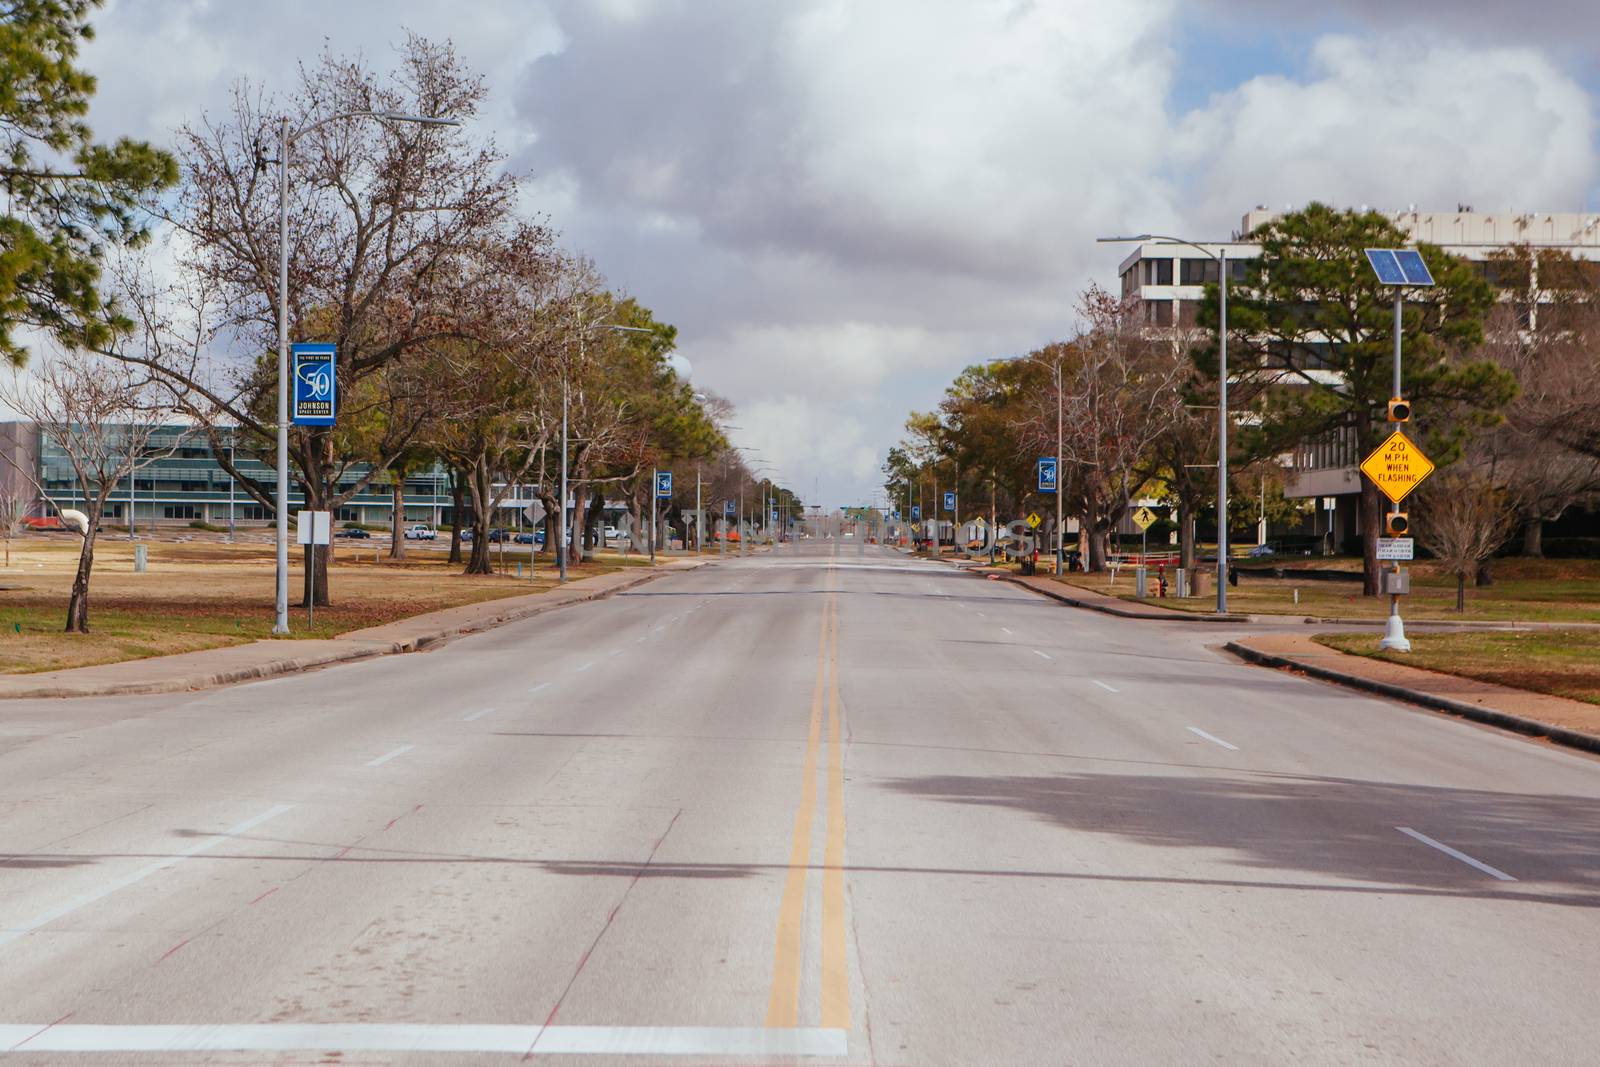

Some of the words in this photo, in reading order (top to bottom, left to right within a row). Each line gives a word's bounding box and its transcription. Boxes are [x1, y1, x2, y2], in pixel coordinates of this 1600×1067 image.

[304, 371, 330, 398] 50
[299, 402, 330, 410] JOHNSON
[1390, 441, 1406, 452] 20
[1387, 463, 1409, 472] WHEN
[1378, 473, 1417, 483] FLASHING
